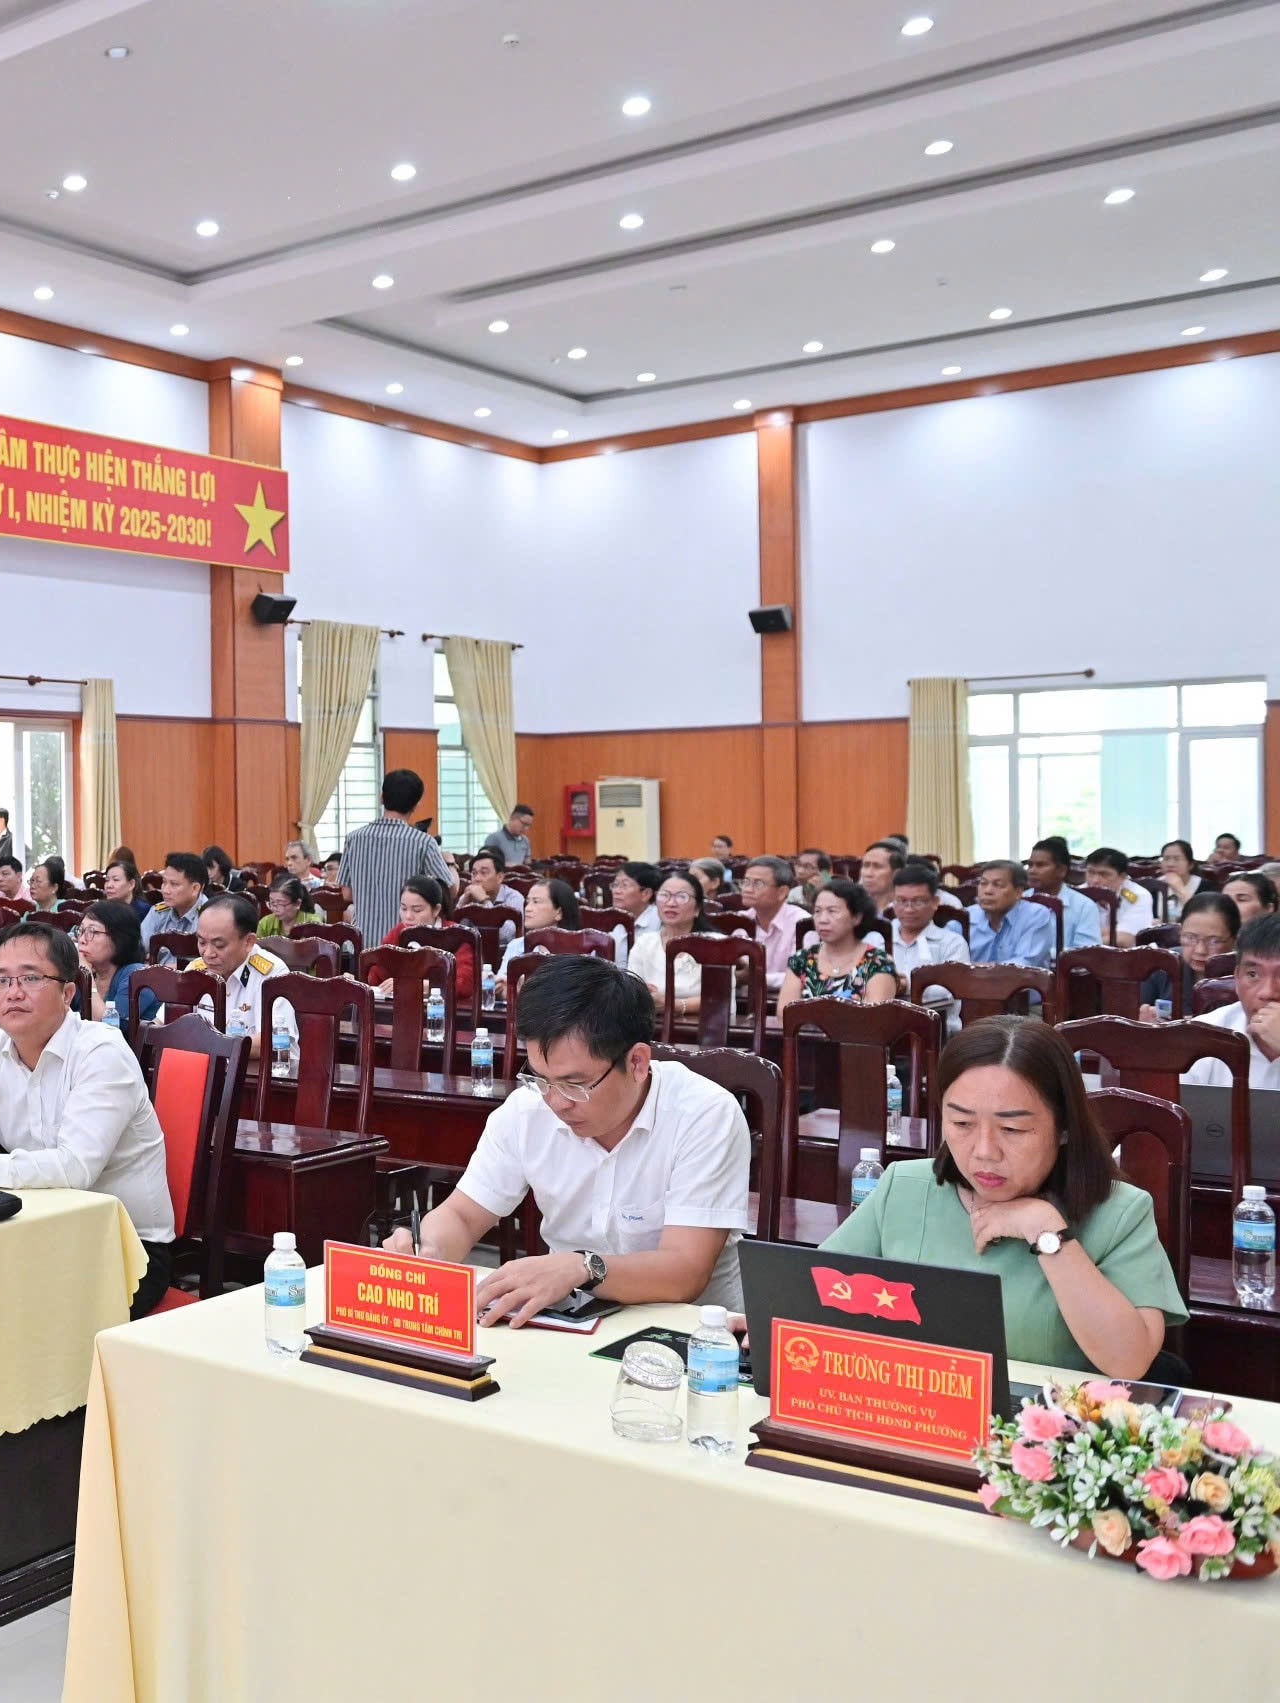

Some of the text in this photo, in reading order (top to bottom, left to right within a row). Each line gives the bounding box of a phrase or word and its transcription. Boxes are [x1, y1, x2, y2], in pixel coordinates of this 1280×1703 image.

[32, 441, 81, 480] THỰC
[85, 448, 128, 489] HIỆN
[131, 455, 187, 497] THẮNG
[191, 471, 216, 502] LỢI
[8, 487, 21, 523] I,
[26, 490, 88, 533] NHIỆM
[92, 498, 116, 532] KỲ
[120, 506, 212, 546] 2025-2030!
[406, 1271, 426, 1285] CHÍ
[357, 1282, 439, 1316] CAO NHO TRÍ
[402, 1319, 420, 1332] TRUNG
[822, 1350, 890, 1385] TRƯƠNG
[895, 1363, 924, 1397] THỊ
[791, 1397, 815, 1410] PHÓ
[845, 1408, 873, 1422] TỊCH
[876, 1414, 911, 1429] HĐND
[914, 1421, 968, 1441] PHƯỜNG
[819, 1387, 937, 1421] UV. BAN THƯỜNG VỤ
